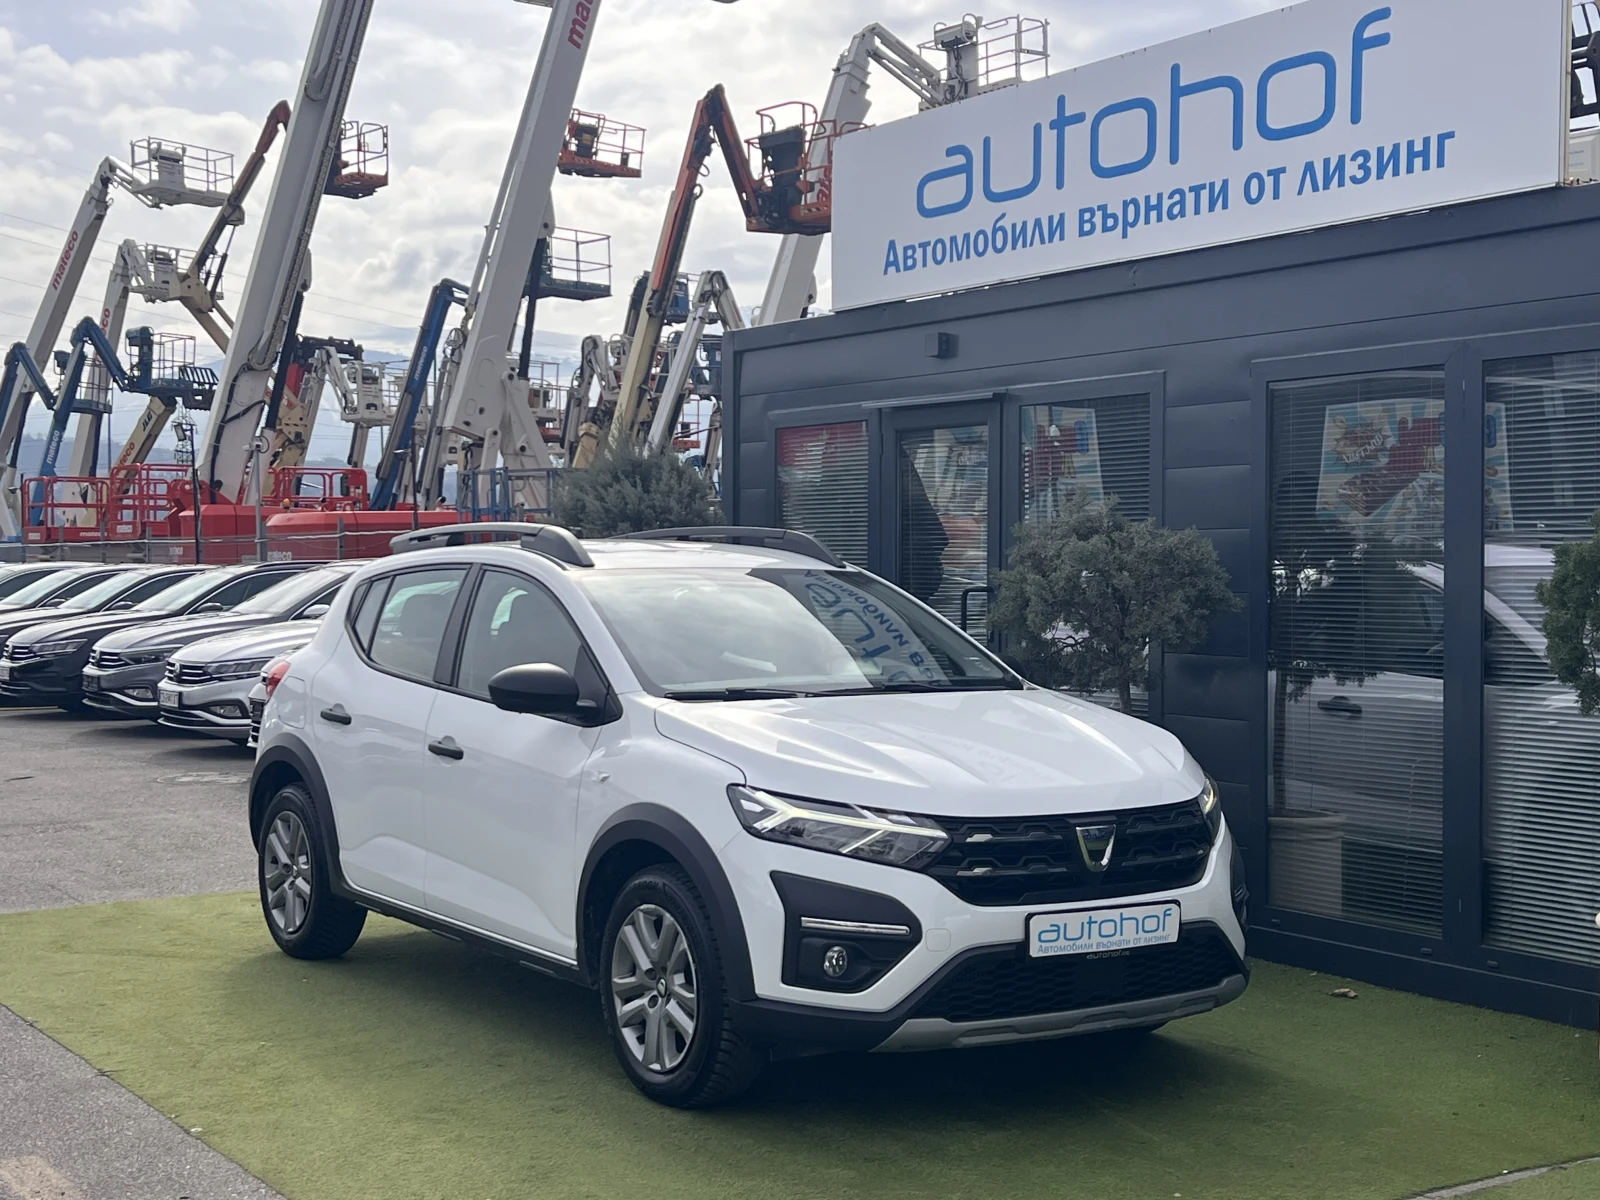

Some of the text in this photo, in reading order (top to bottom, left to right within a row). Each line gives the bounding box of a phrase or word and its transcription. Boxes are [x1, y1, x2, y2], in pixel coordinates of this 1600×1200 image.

[567, 0, 594, 50] ma
[916, 6, 1392, 218] autohof
[882, 130, 1456, 276] Автомобили върнати от лизинг
[52, 230, 78, 291] mateco
[414, 345, 428, 381] mateco
[142, 411, 153, 432] JLG
[46, 430, 60, 464] mateco
[1037, 907, 1173, 944] autohof
[1037, 934, 1171, 955] Автомобили върнати от лизинг
